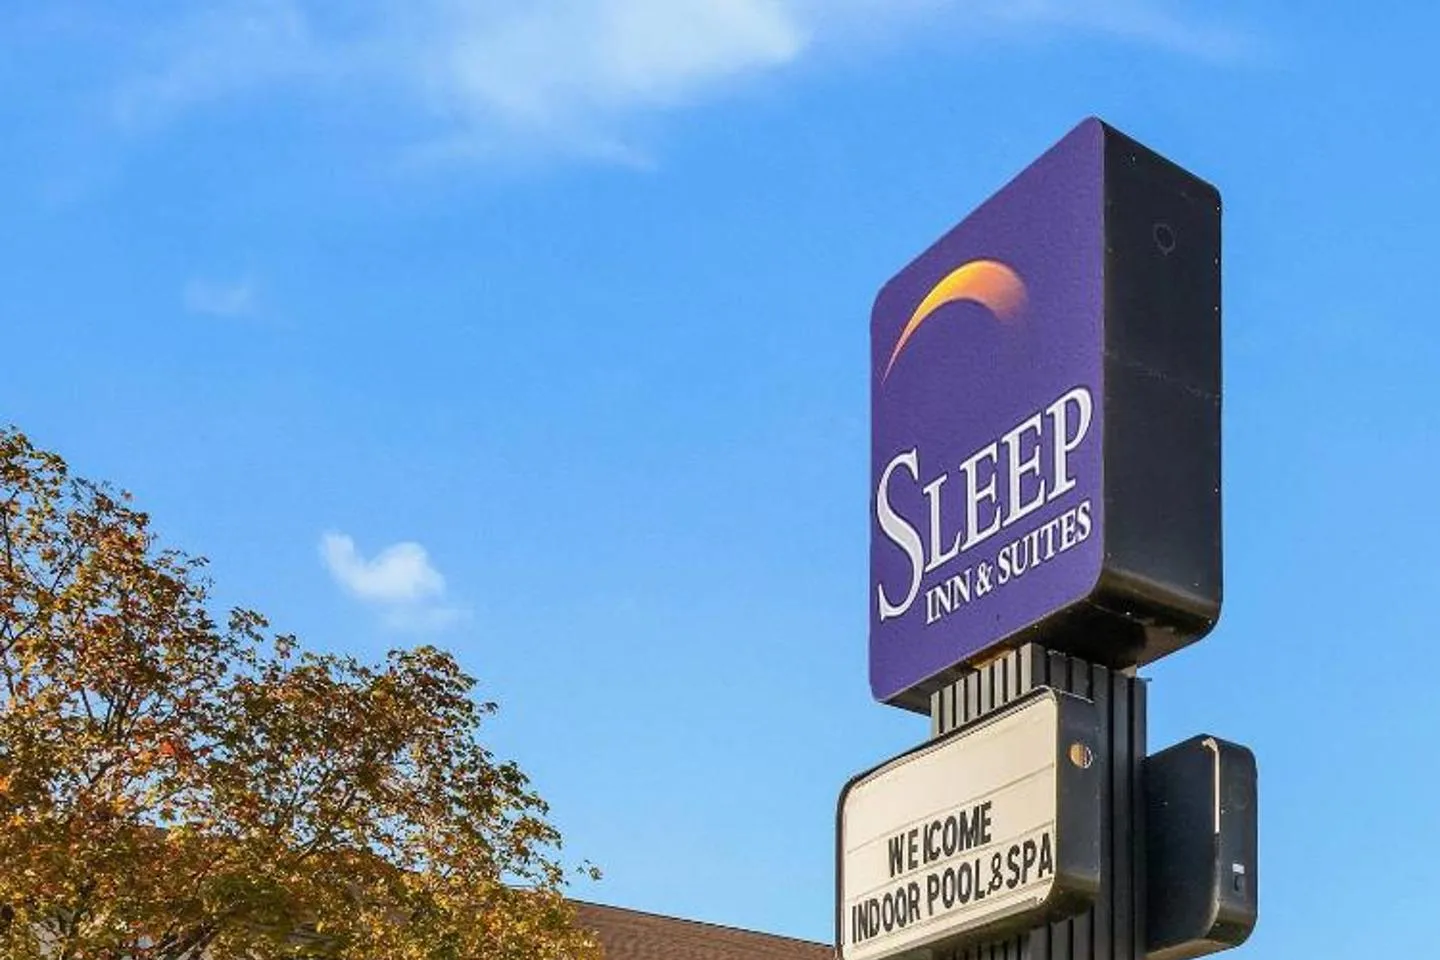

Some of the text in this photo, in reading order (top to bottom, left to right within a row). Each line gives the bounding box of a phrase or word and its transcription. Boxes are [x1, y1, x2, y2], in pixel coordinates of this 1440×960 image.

[876, 386, 1094, 622] SLEEP
[926, 500, 1092, 625] INN & SUITES
[852, 881, 921, 944] INDOOR
